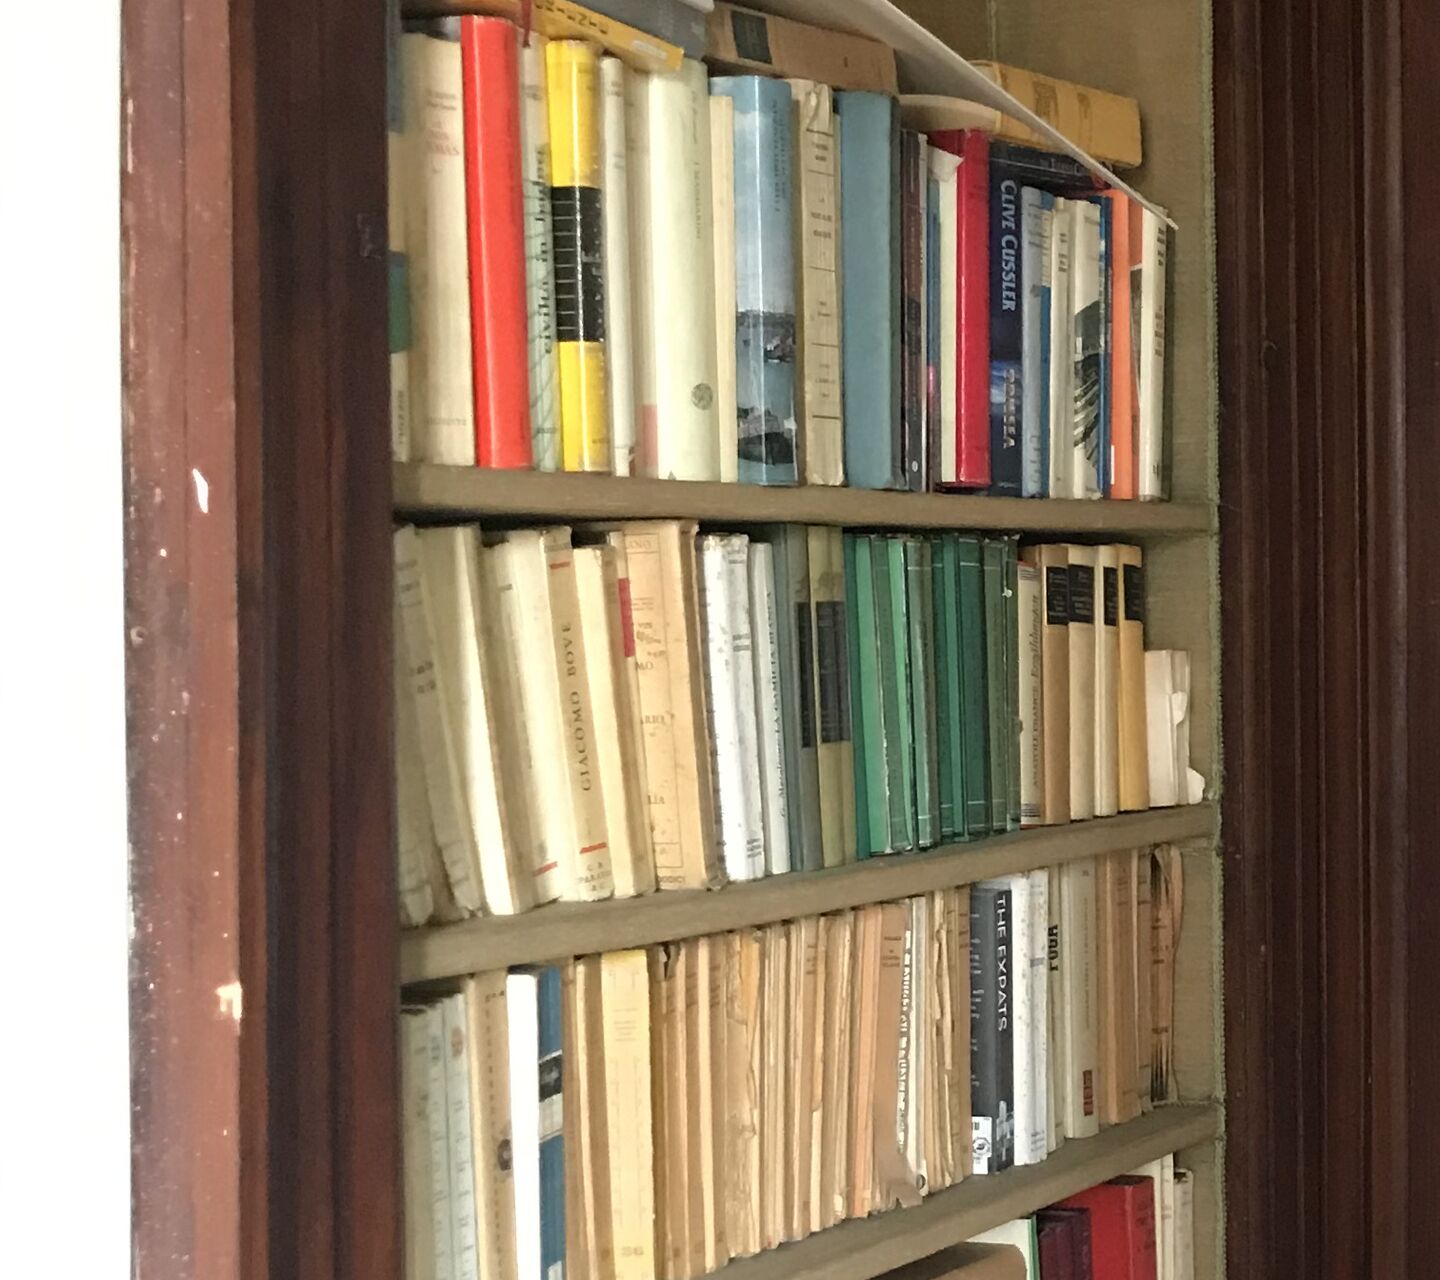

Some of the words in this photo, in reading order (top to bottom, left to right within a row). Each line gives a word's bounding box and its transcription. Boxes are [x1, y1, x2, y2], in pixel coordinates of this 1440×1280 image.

[1000, 179, 1018, 231] CLIVE
[1001, 235, 1018, 312] CUSSLER
[1003, 368, 1017, 449] ODESSA
[561, 623, 578, 678] BOVE
[570, 690, 593, 792] GIACOMO
[995, 894, 1007, 939] THE
[998, 944, 1009, 1033] EXPATS
